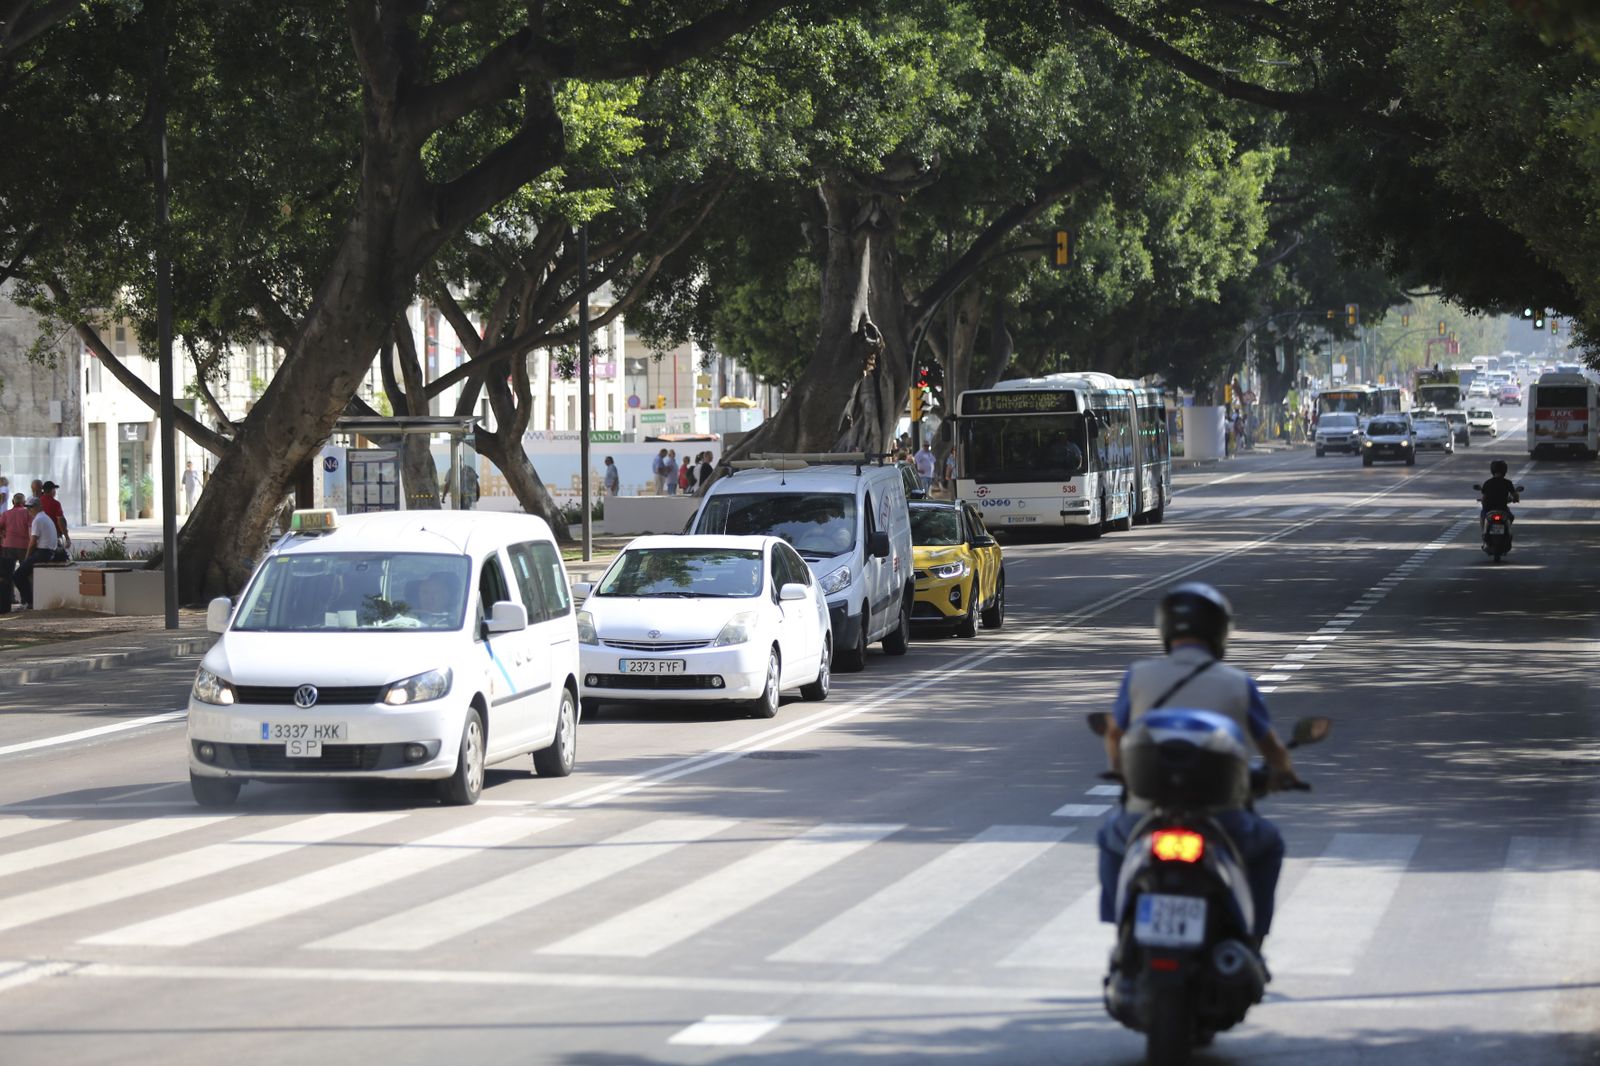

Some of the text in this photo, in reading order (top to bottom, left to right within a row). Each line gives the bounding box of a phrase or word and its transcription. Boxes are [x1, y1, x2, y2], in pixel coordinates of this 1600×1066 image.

[978, 396, 993, 410] 11
[553, 433, 580, 441] acciona
[590, 433, 620, 441] ANDO
[324, 460, 338, 469] N4
[1062, 485, 1077, 493] 538
[629, 662, 679, 673] 2373 FYF
[274, 725, 340, 738] 3337 HXK
